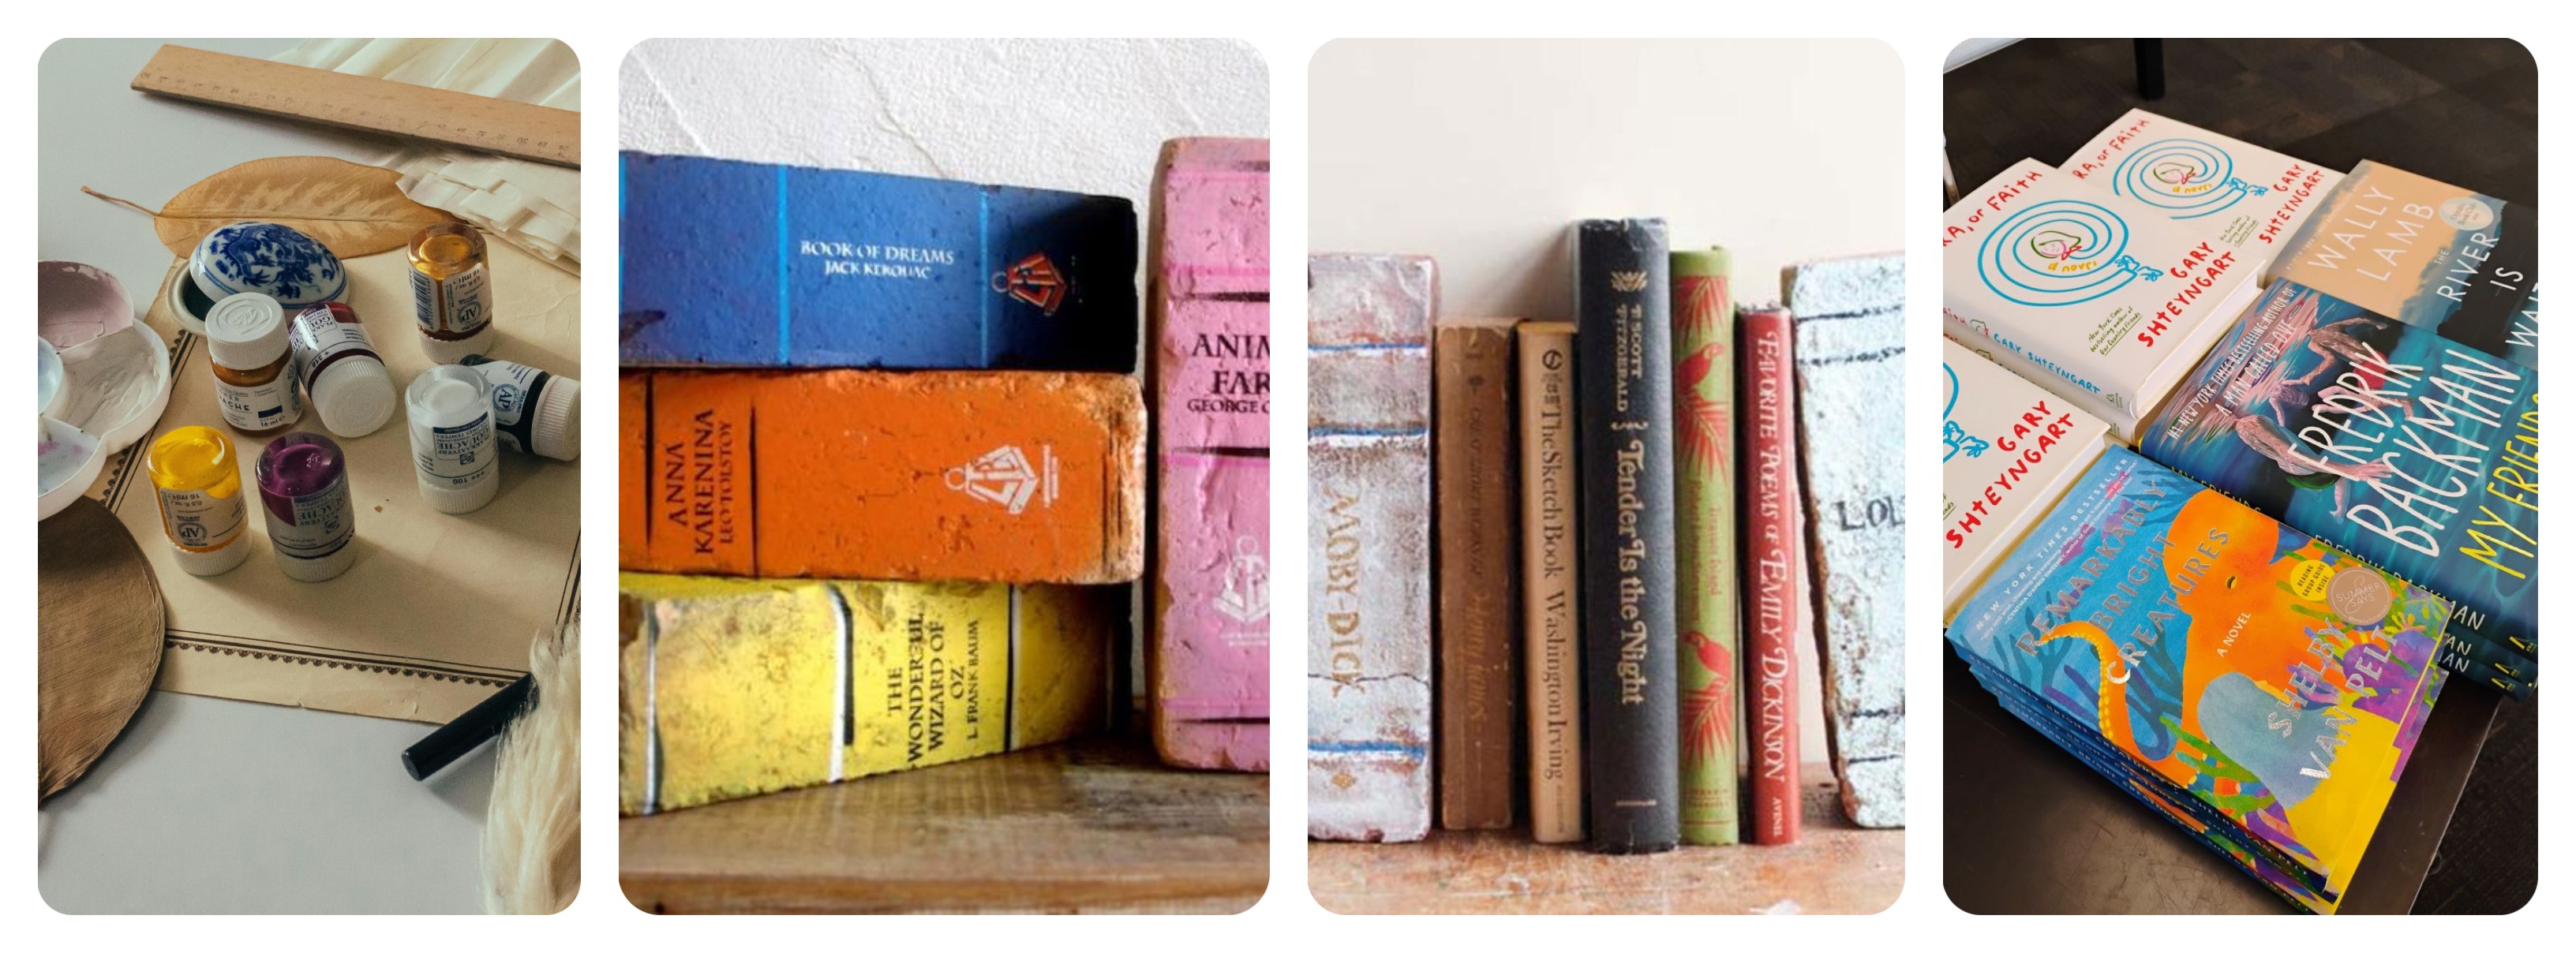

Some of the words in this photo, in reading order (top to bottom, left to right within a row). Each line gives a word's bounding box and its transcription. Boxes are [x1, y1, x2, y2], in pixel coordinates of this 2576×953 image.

[2273, 163, 2305, 192] GARY
[2307, 185, 2394, 270] WALLY
[2357, 202, 2434, 282] LAMB
[800, 240, 854, 257] BOOK
[856, 242, 881, 259] OF
[883, 245, 955, 265] DREAMS
[824, 260, 860, 276] JACK
[863, 263, 932, 279] KEROUAC
[2170, 241, 2215, 279] GARY
[2434, 249, 2451, 266] THE
[2436, 231, 2499, 302] RIVER
[2489, 267, 2524, 291] IS
[1993, 333, 2022, 353] GARY
[2271, 318, 2297, 345] OVE
[1616, 304, 1629, 413] FITZGERALD
[2167, 425, 2181, 439] #1
[2178, 405, 2199, 428] NEW
[2192, 383, 2217, 409] YORK
[2211, 359, 2237, 387] TIMES
[2230, 321, 2268, 365] BESTSELLING
[2263, 295, 2290, 327] AUTHOR
[2282, 287, 2298, 300] OF
[2244, 342, 2280, 380] CALLED
[497, 387, 513, 409] AP
[1186, 398, 1259, 413] GEORGE
[1757, 331, 1780, 439] FAVORITE
[2223, 376, 2252, 406] MAN
[1541, 409, 1563, 449] The
[1997, 400, 2051, 452] GARY
[2215, 403, 2233, 417] A
[2287, 342, 2424, 482] FREDRIK
[437, 428, 489, 450] GOUACHE
[719, 420, 733, 502] TOLSTOY
[2346, 349, 2522, 558] BACKMAN
[665, 442, 688, 527] ANNA
[695, 408, 714, 554] KARENINA
[1541, 450, 1563, 520] Sketch
[1618, 439, 1645, 537] Tender
[1760, 446, 1782, 519] POEMS
[182, 527, 200, 538] AP
[720, 508, 733, 544] LEO
[1974, 600, 2001, 630] NEW
[2004, 564, 2033, 595] YORK
[2037, 525, 2068, 559] TIMES
[2070, 458, 2128, 521] BESTSELLER
[2065, 539, 2079, 554] author
[2459, 505, 2538, 580] MY
[1544, 525, 1566, 579] Book
[1619, 538, 1646, 572] Is
[2015, 480, 2166, 657] REMARKABLY
[2297, 564, 2315, 587] READING
[1322, 485, 1365, 698] MOBY-DICK
[1620, 575, 1646, 620] the
[1760, 549, 1787, 643] EMILY
[2087, 530, 2176, 632] BRIGHT
[2302, 579, 2316, 597] GROUP
[2312, 563, 2327, 580] GUIDE
[2315, 574, 2330, 593] INSIDE
[2335, 581, 2382, 602] SUMMER
[2348, 593, 2376, 608] SAYS
[2106, 527, 2230, 684] CREATURES
[928, 620, 945, 653] OF
[968, 619, 979, 667] BAUM
[1543, 589, 1566, 716] Washington
[2216, 647, 2228, 657] A
[2222, 611, 2252, 647] NOVEL
[949, 665, 964, 700] OZ
[1618, 621, 1649, 704] Night
[2267, 617, 2349, 738] SHELBY
[2345, 624, 2399, 700] PELT
[887, 667, 903, 716] THE
[928, 657, 945, 752] WIZARD
[967, 670, 979, 724] FRANK
[1761, 647, 1788, 783] DICKINSON
[2044, 704, 2088, 733] BRIGHT
[2299, 705, 2358, 779] VAN
[1544, 719, 1567, 780] Irving
[2077, 749, 2116, 778] BRIGHT
[2190, 798, 2237, 830] SHELBY
